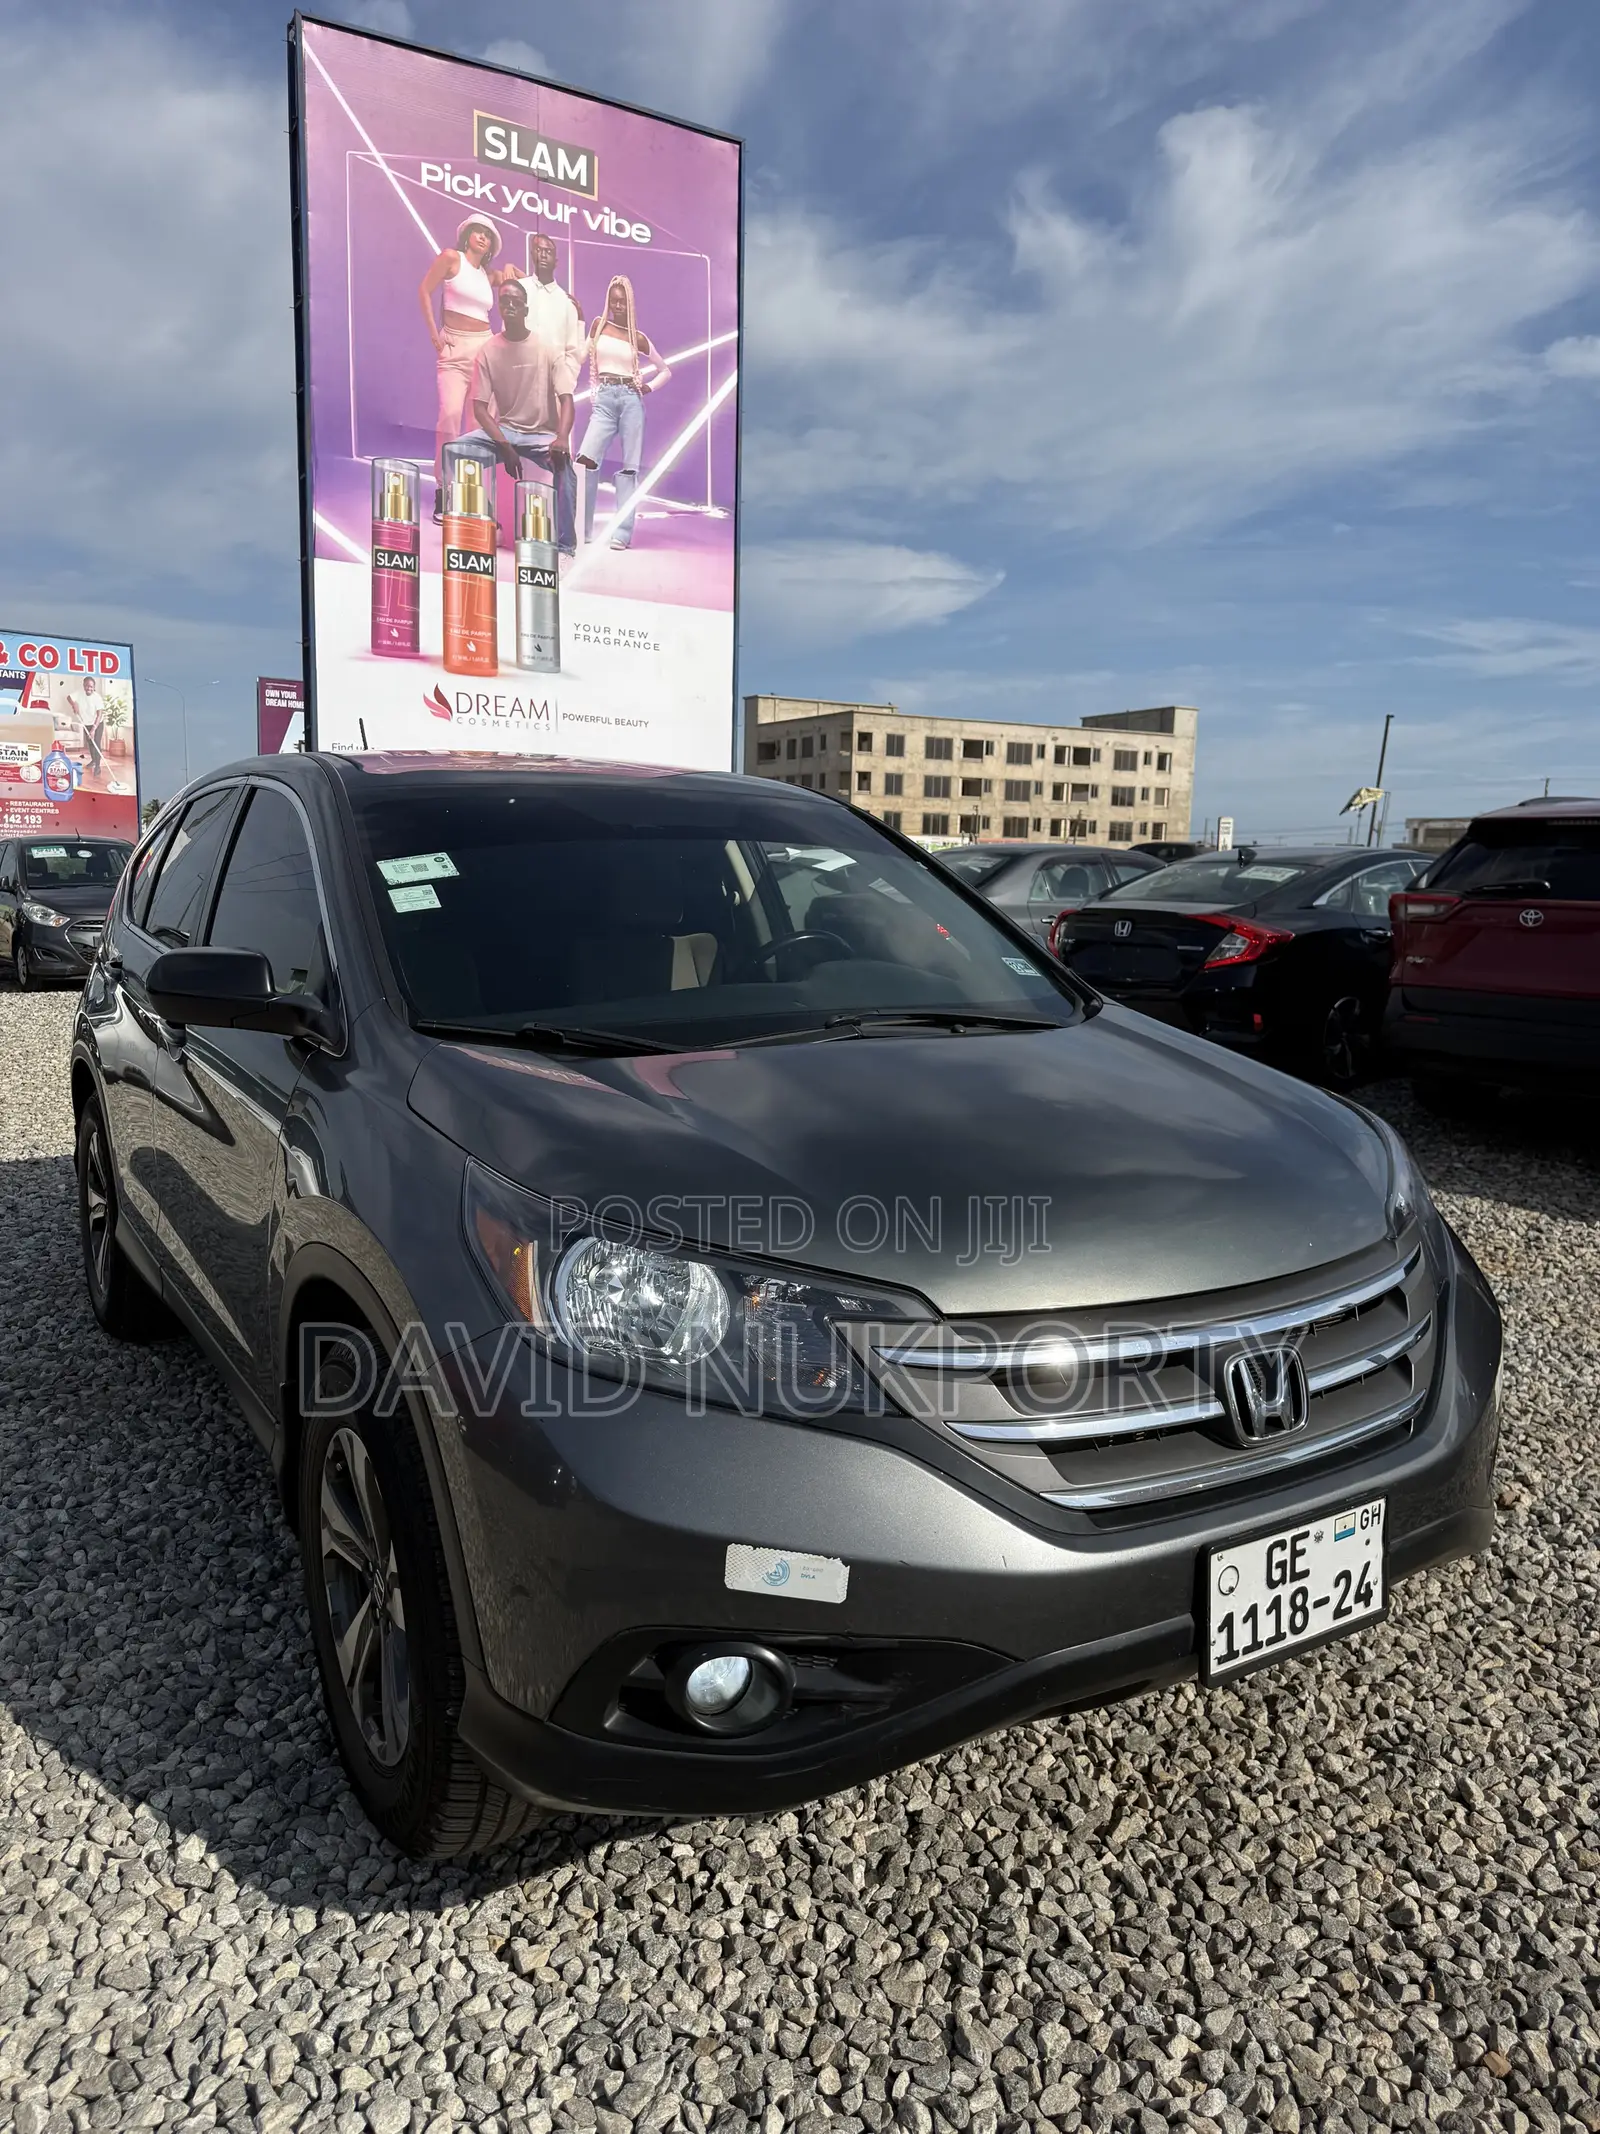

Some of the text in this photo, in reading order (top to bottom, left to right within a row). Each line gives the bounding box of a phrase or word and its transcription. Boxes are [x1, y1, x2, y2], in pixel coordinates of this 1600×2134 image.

[484, 125, 588, 187] SLAM
[420, 161, 652, 244] Pick your vibe
[376, 552, 415, 570] SLAM
[449, 552, 492, 573] SLAM
[519, 569, 555, 587] SLAM
[574, 622, 650, 639] YOUR NEW
[574, 633, 661, 651] FRAGRANCE
[18, 643, 60, 669] CO
[68, 648, 120, 675] LTD
[265, 689, 297, 699] OWN YOUR
[266, 698, 304, 709] DREAM HOME
[456, 692, 550, 721] DREAM
[456, 716, 550, 731] COSMETICS
[562, 712, 649, 728] POWERFUL BEAUTY
[3, 813, 42, 824] 142 193
[1360, 1503, 1382, 1530] GH
[1266, 1529, 1310, 1590] GE
[1216, 1560, 1373, 1666] 1118-24
